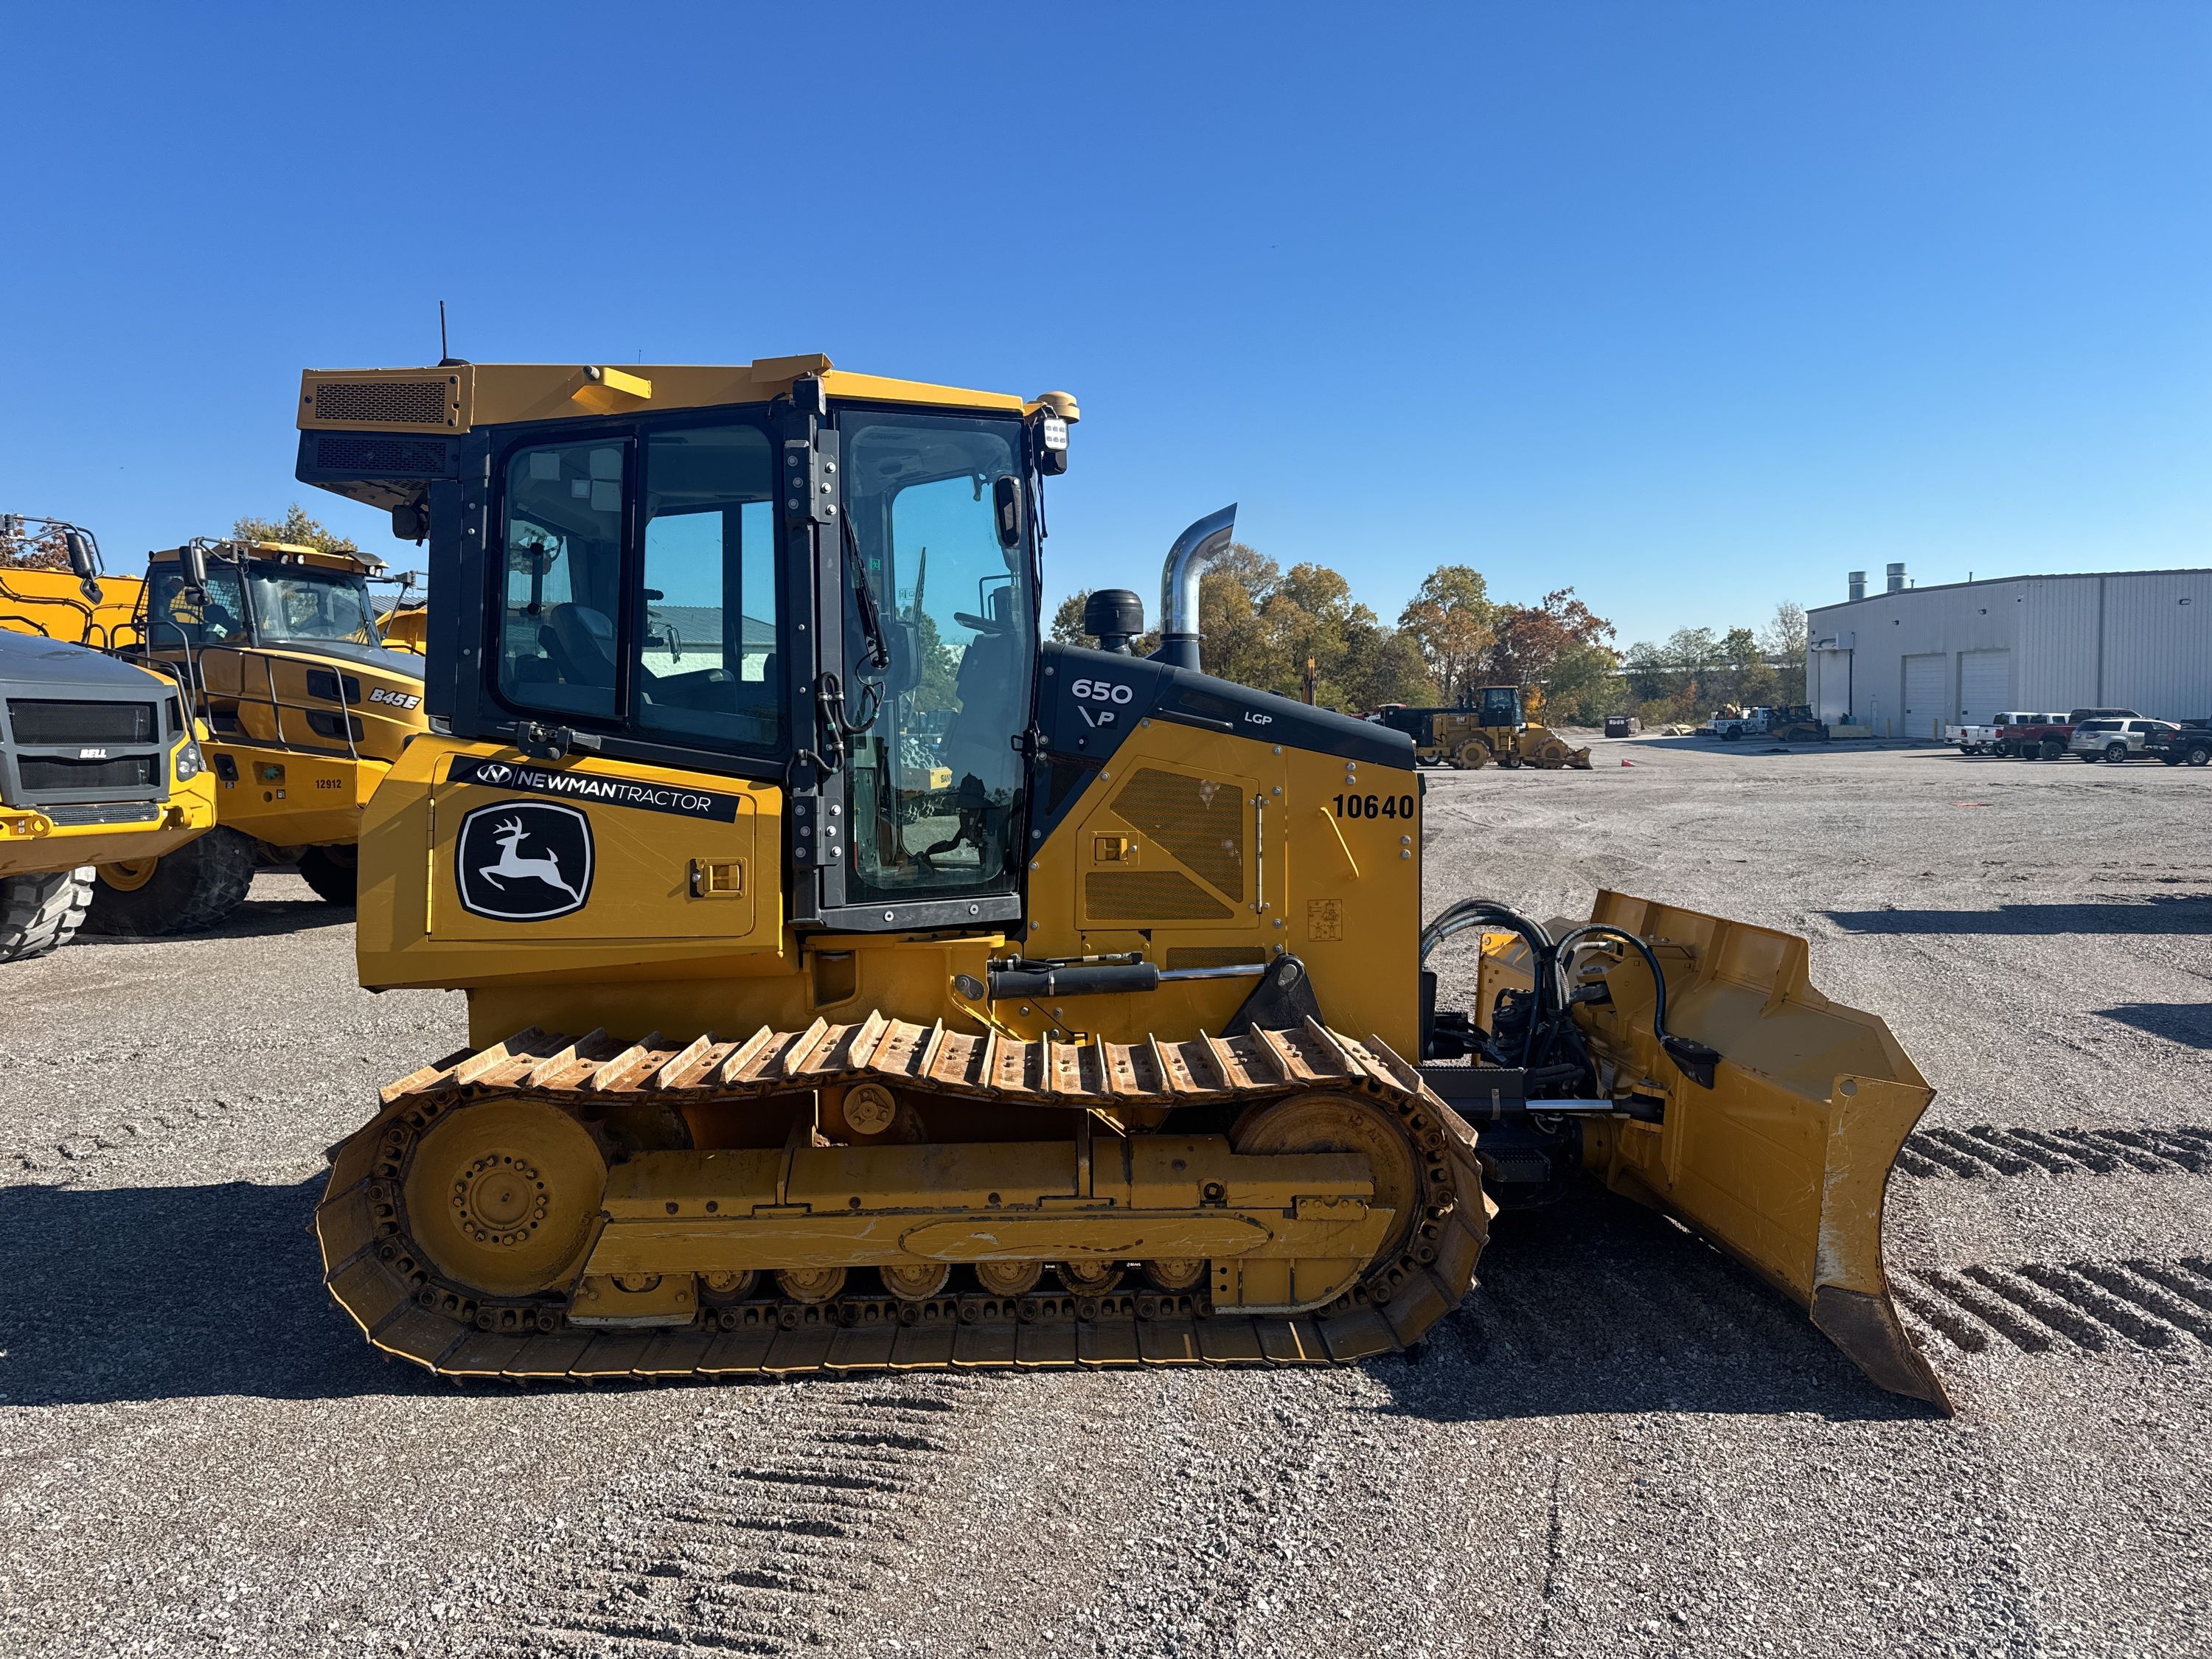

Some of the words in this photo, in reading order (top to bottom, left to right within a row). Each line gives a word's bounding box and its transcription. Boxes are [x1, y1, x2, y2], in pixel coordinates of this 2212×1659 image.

[368, 687, 422, 710] B45E
[1071, 678, 1133, 704] 650
[1244, 712, 1273, 726] LGP
[79, 748, 107, 759] BELL
[316, 779, 342, 789] 12912
[517, 771, 712, 812] NEWMANTRACTOR
[1333, 793, 1414, 820] 10640
